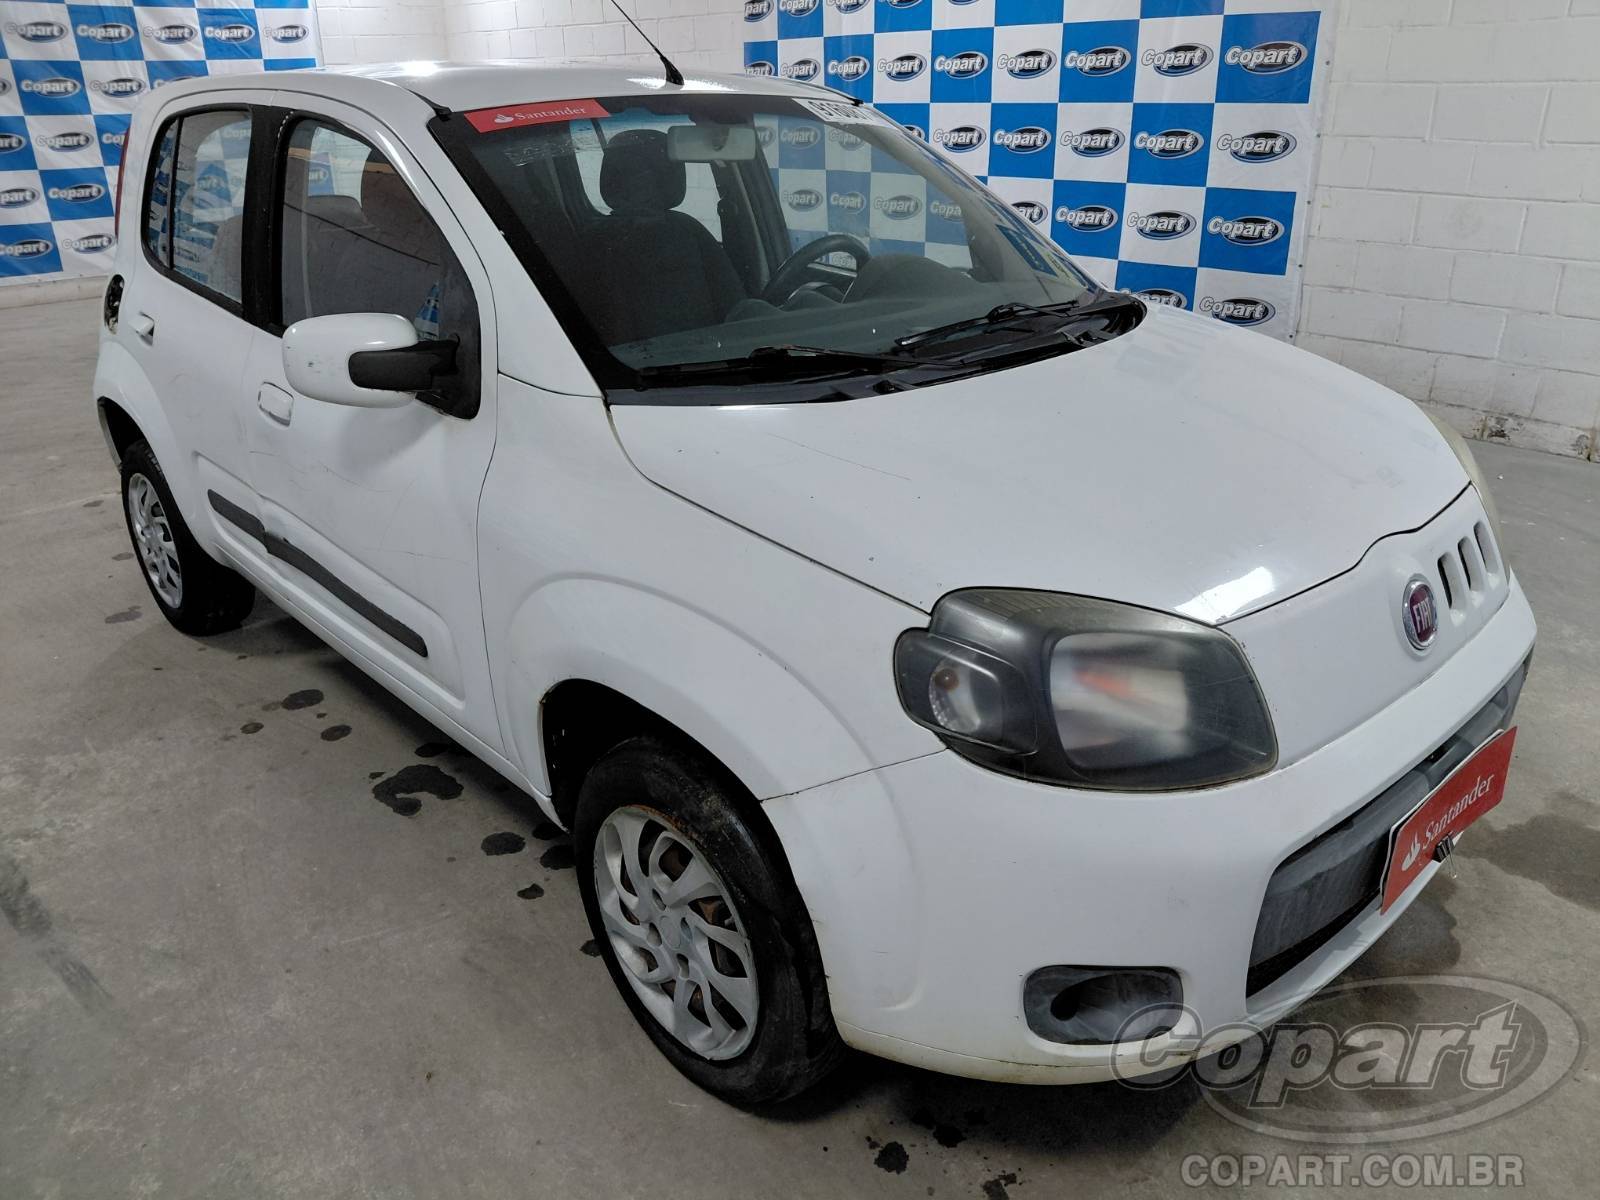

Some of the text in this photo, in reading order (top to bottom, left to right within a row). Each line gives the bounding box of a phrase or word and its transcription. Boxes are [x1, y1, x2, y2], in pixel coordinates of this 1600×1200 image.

[745, 0, 769, 17] part
[5, 22, 61, 38] Copart
[76, 24, 128, 39] Copart
[143, 26, 190, 40] Copart
[204, 26, 250, 40] Copart
[263, 26, 304, 39] Copart
[877, 58, 921, 75] Copart
[934, 56, 983, 73] Copart
[997, 54, 1049, 72] Copart
[1064, 51, 1122, 72] Copart
[1141, 49, 1204, 69] Copart
[1225, 46, 1298, 70] Copart
[745, 65, 769, 77] part
[780, 63, 815, 78] Copart
[828, 60, 864, 76] Copart
[21, 80, 74, 94] Copart
[89, 80, 138, 94] Copart
[515, 106, 587, 121] Santander
[36, 135, 87, 149] Copart
[102, 133, 125, 145] Cop
[933, 129, 980, 147] Copart
[993, 129, 1044, 147] Copart
[1060, 131, 1117, 150] Copart
[1134, 131, 1195, 153] Copart
[1216, 134, 1286, 154] Copart
[0, 190, 33, 204] part
[48, 186, 99, 202] Copart
[873, 198, 917, 214] Copart
[930, 201, 962, 218] Copa
[1017, 205, 1042, 221] art
[1056, 206, 1111, 226] Copart
[1127, 212, 1186, 232] Copart
[1207, 217, 1276, 239] Copart
[62, 236, 110, 251] Copart
[1199, 297, 1267, 319] Copart
[1412, 597, 1434, 634] FIAT
[1422, 774, 1495, 849] Santander
